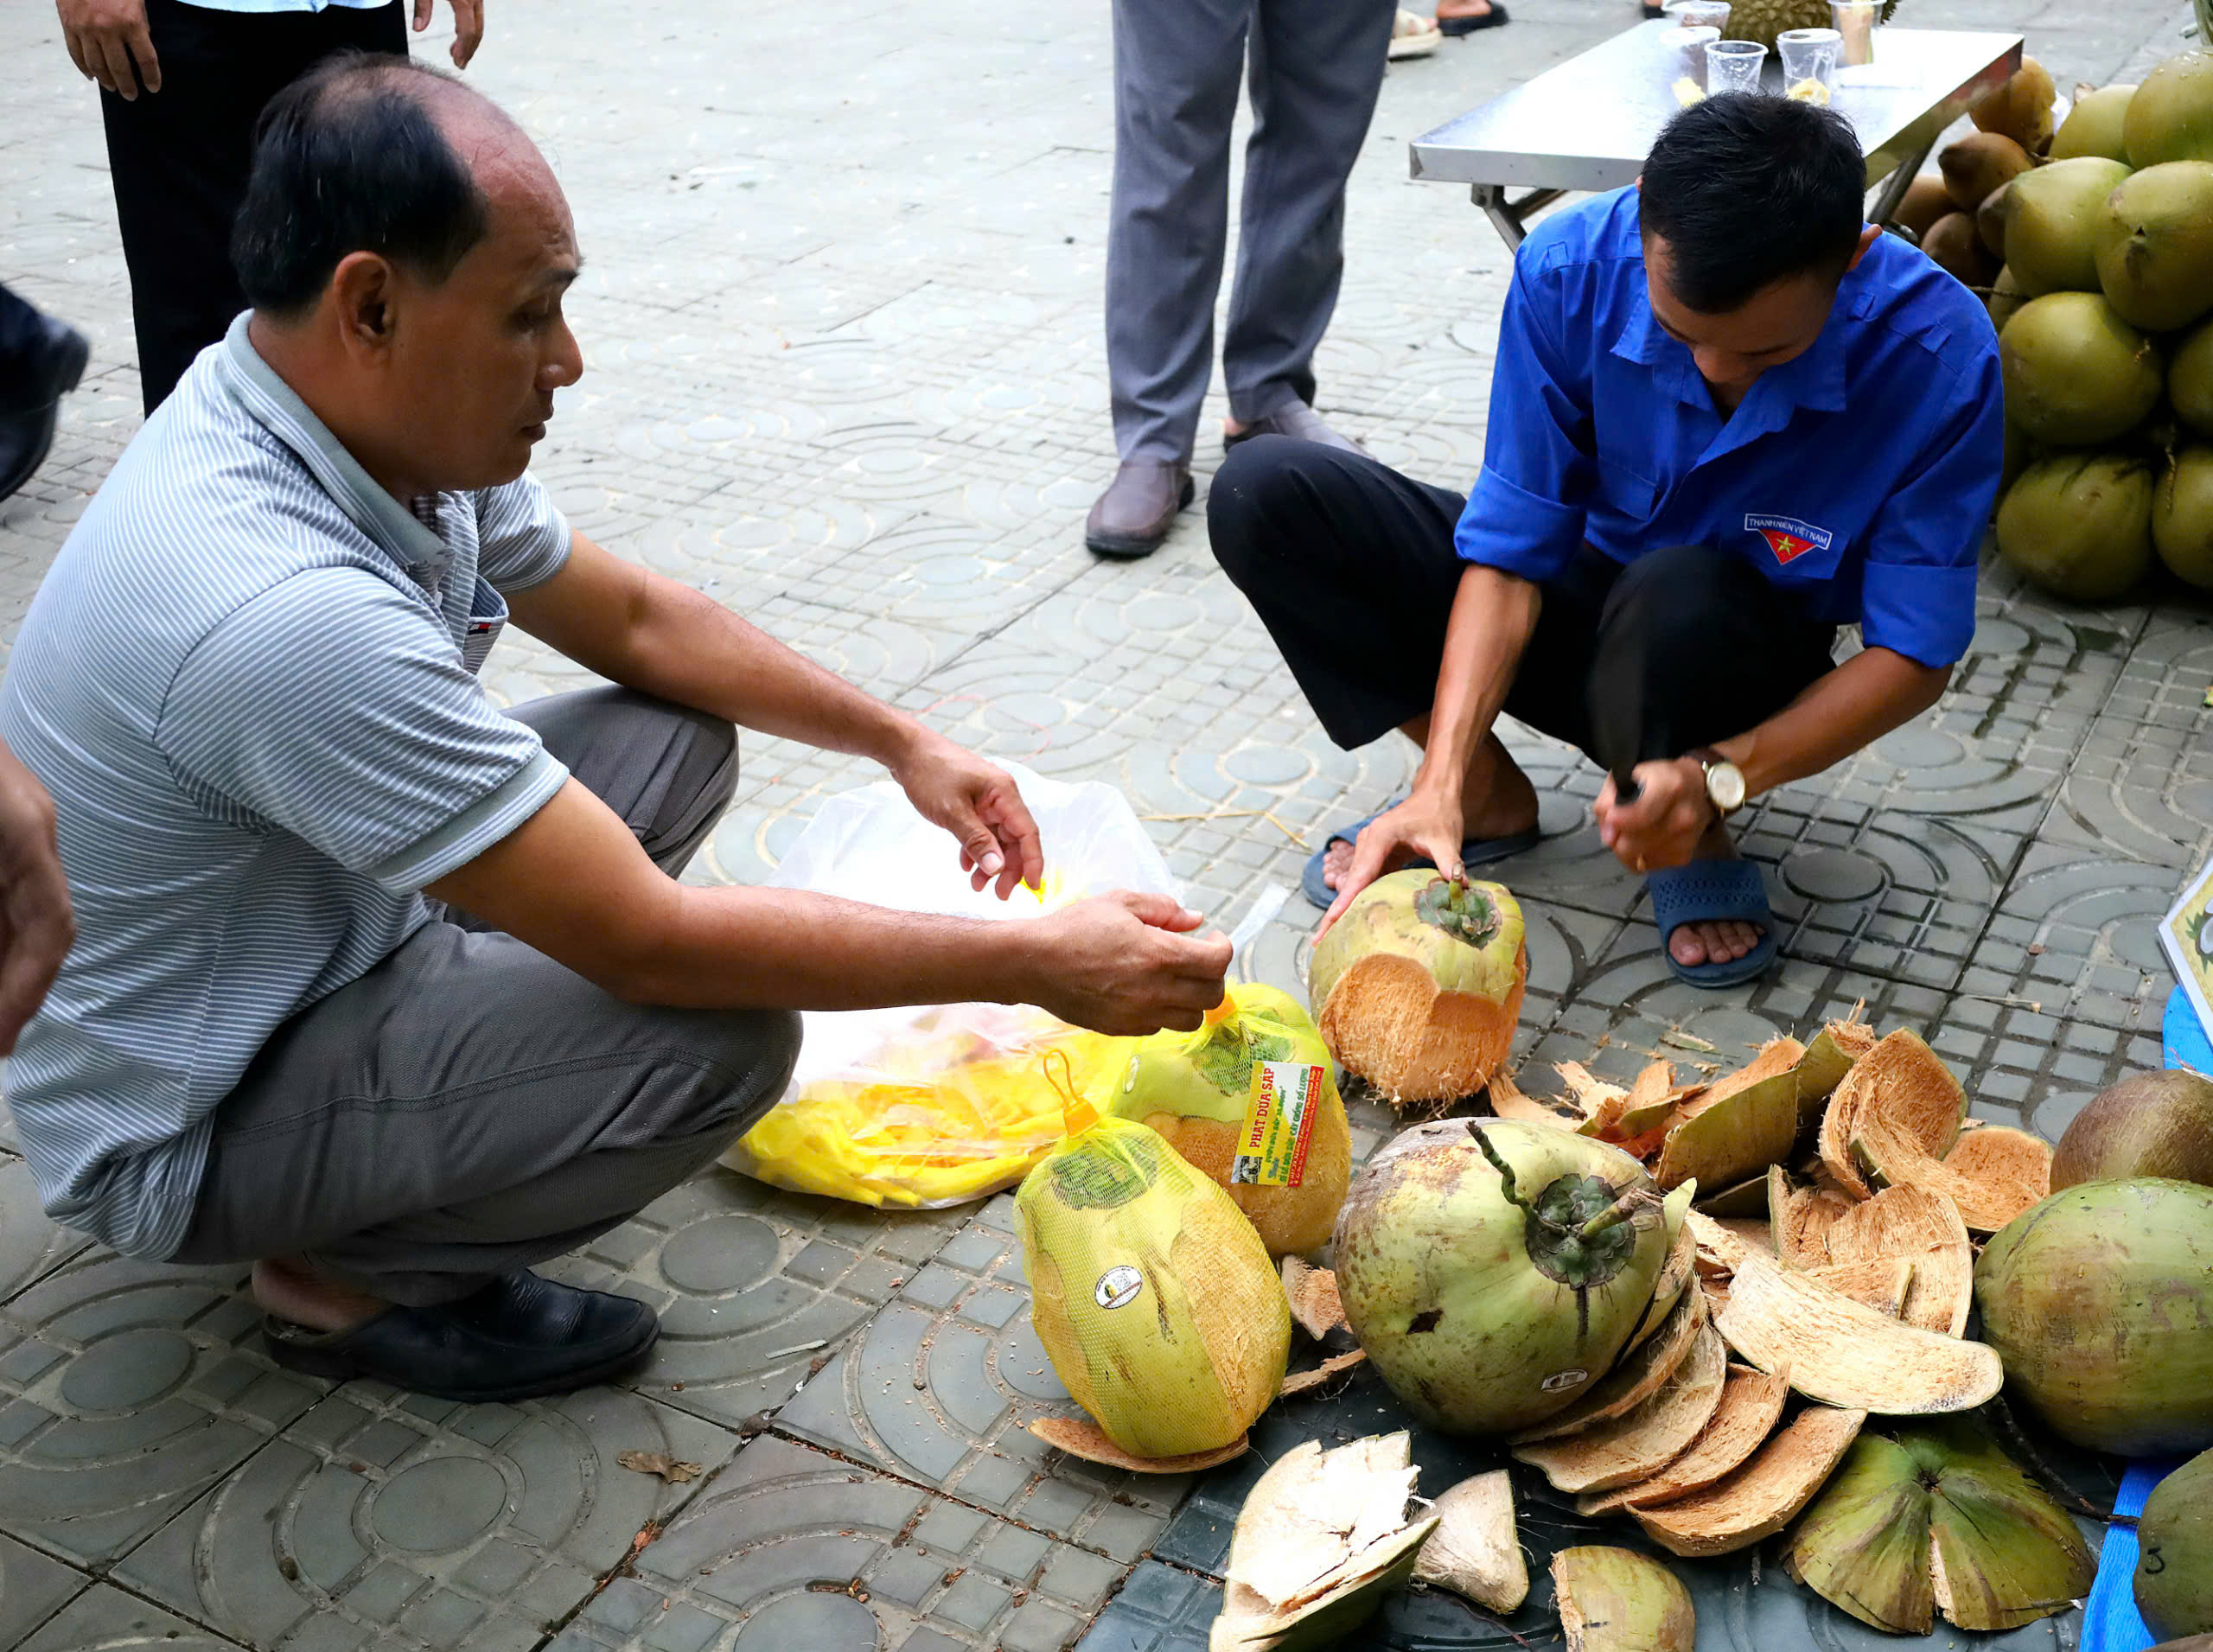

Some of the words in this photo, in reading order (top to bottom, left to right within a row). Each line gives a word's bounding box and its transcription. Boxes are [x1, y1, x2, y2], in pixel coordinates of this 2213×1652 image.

[1749, 518, 1776, 527] THANH
[1776, 520, 1794, 532] NIÊN
[1794, 525, 1809, 536] VIỆT
[1809, 532, 1827, 545] NAM
[1260, 1068, 1275, 1091] SÁP
[1256, 1093, 1272, 1118] DỪA
[1249, 1119, 1266, 1148] PHÁT
